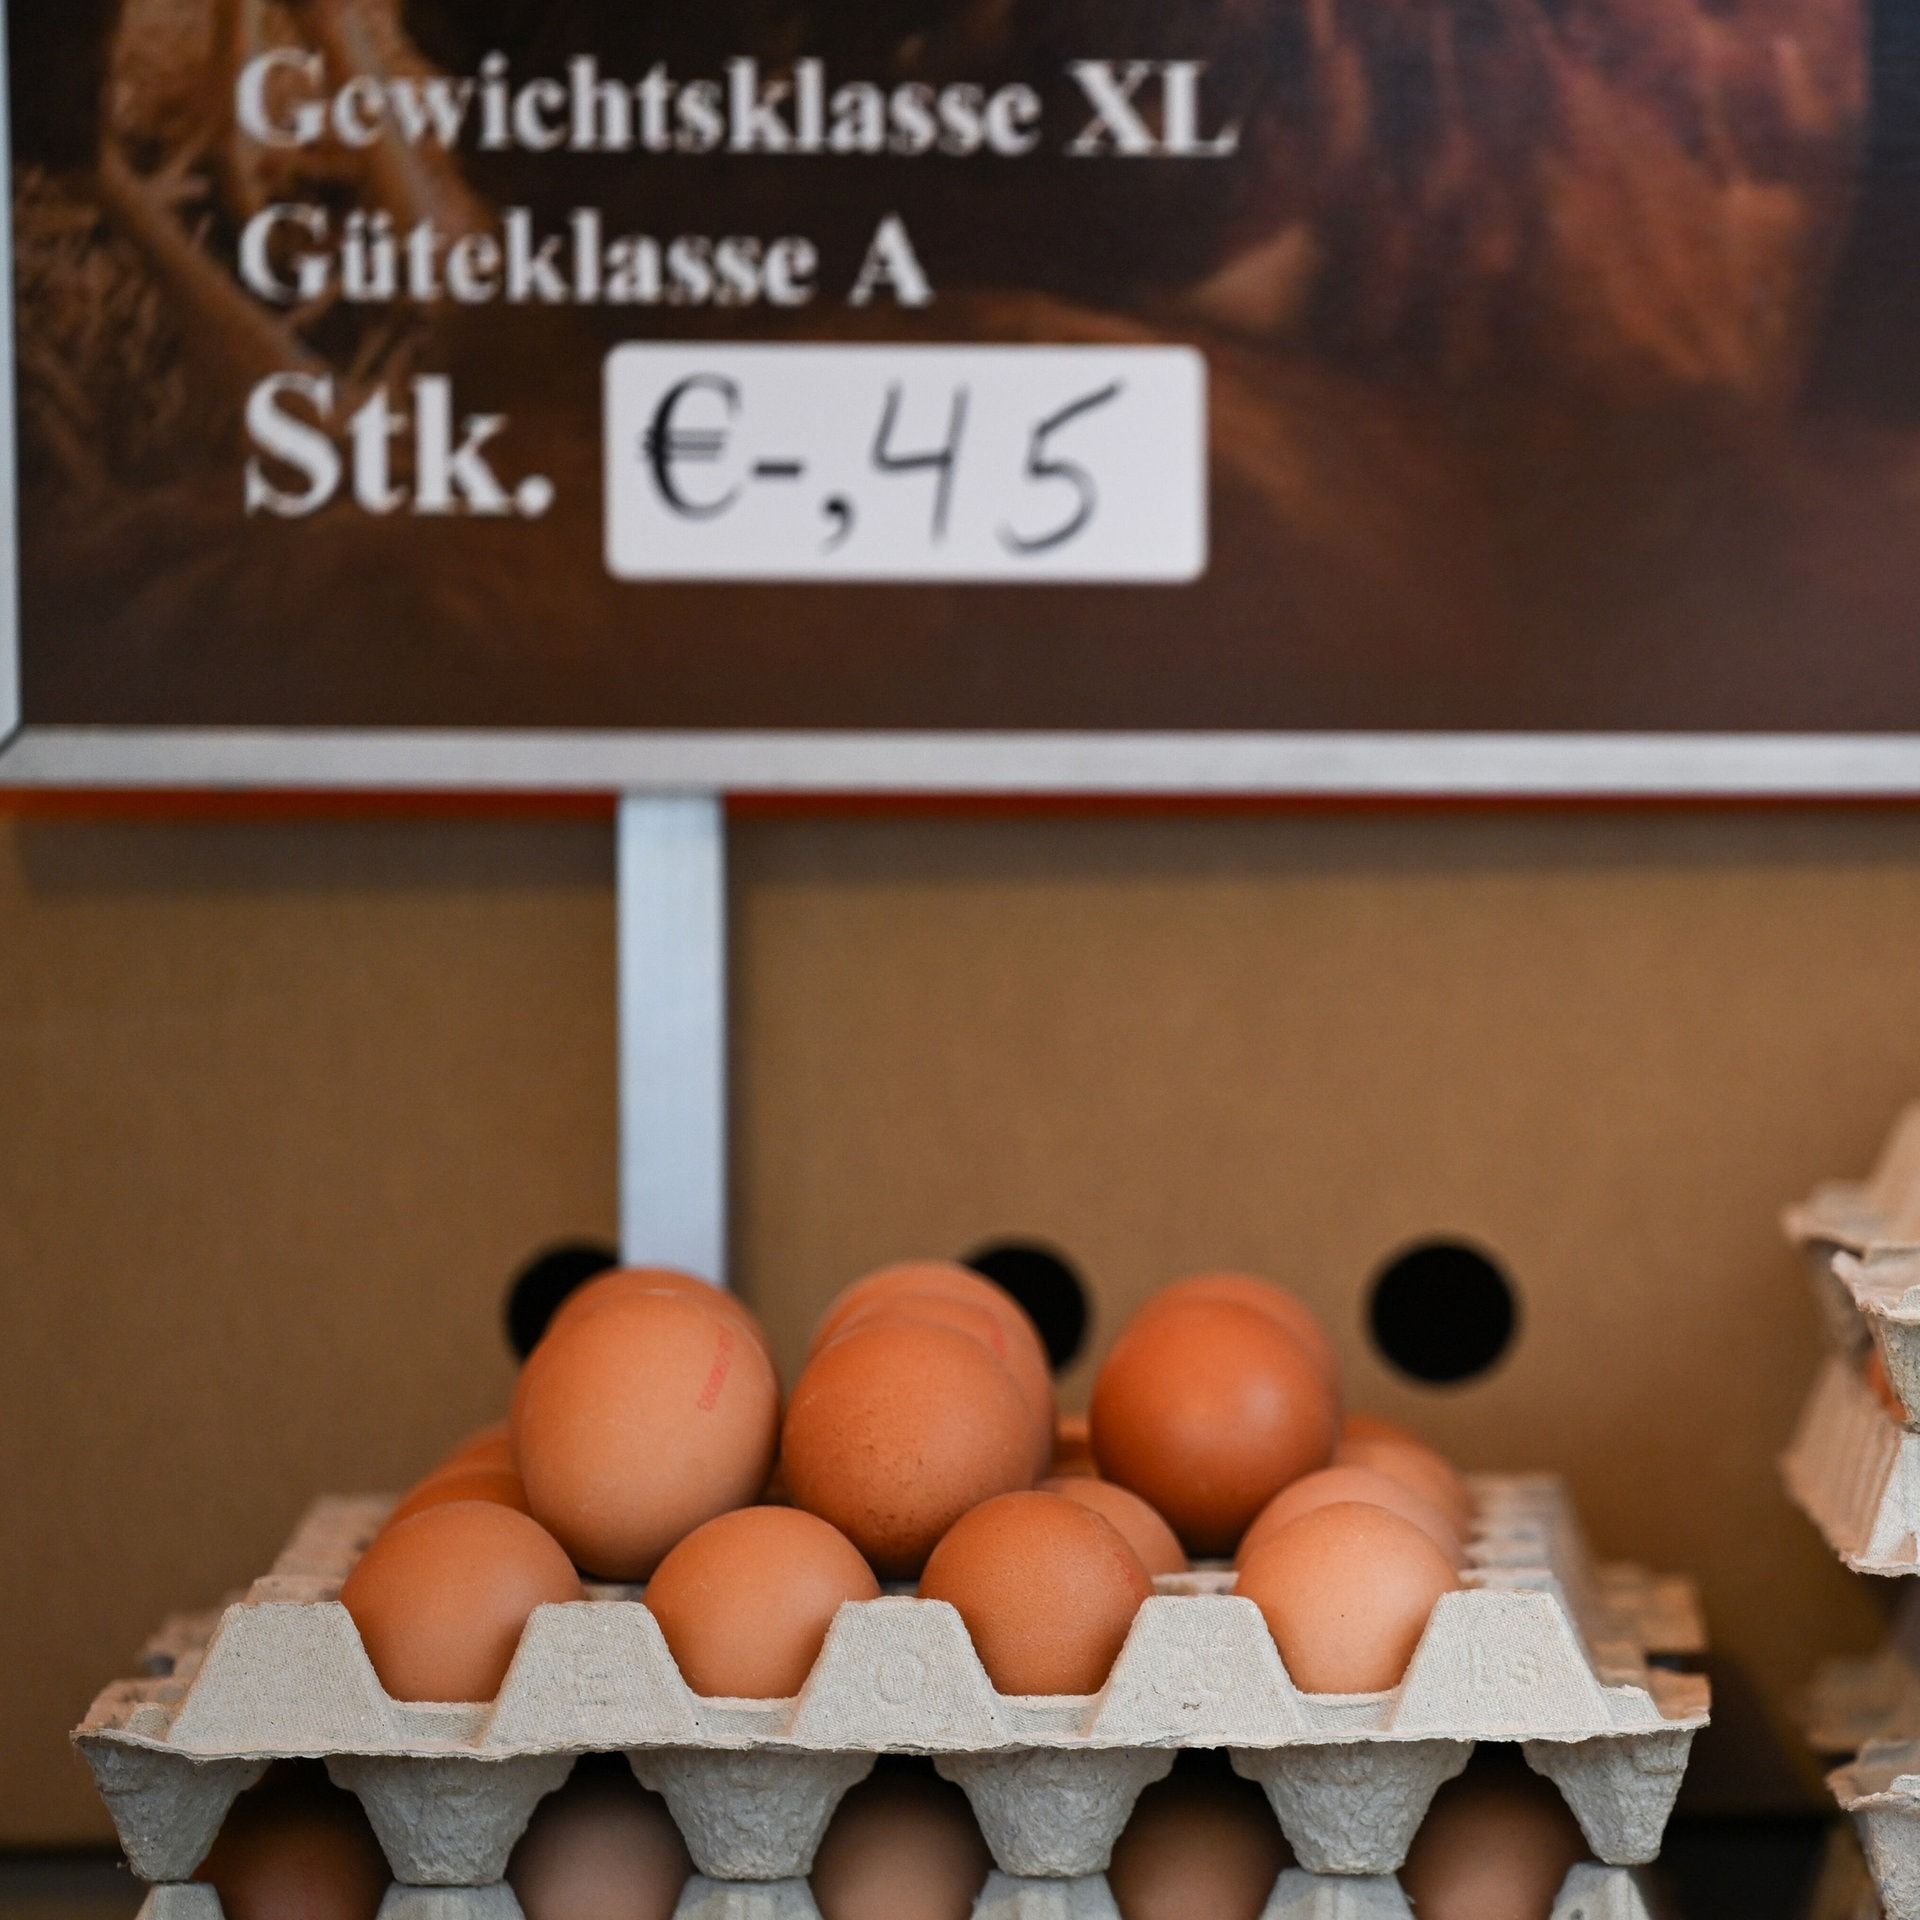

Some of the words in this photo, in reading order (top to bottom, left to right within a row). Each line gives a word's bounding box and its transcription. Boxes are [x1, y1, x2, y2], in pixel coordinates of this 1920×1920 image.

[234, 46, 1042, 158] Gewichtsklasse
[1065, 58, 1243, 159] XL
[238, 202, 818, 307] Güteklasse
[847, 210, 934, 307] A
[243, 370, 556, 518] Stk.
